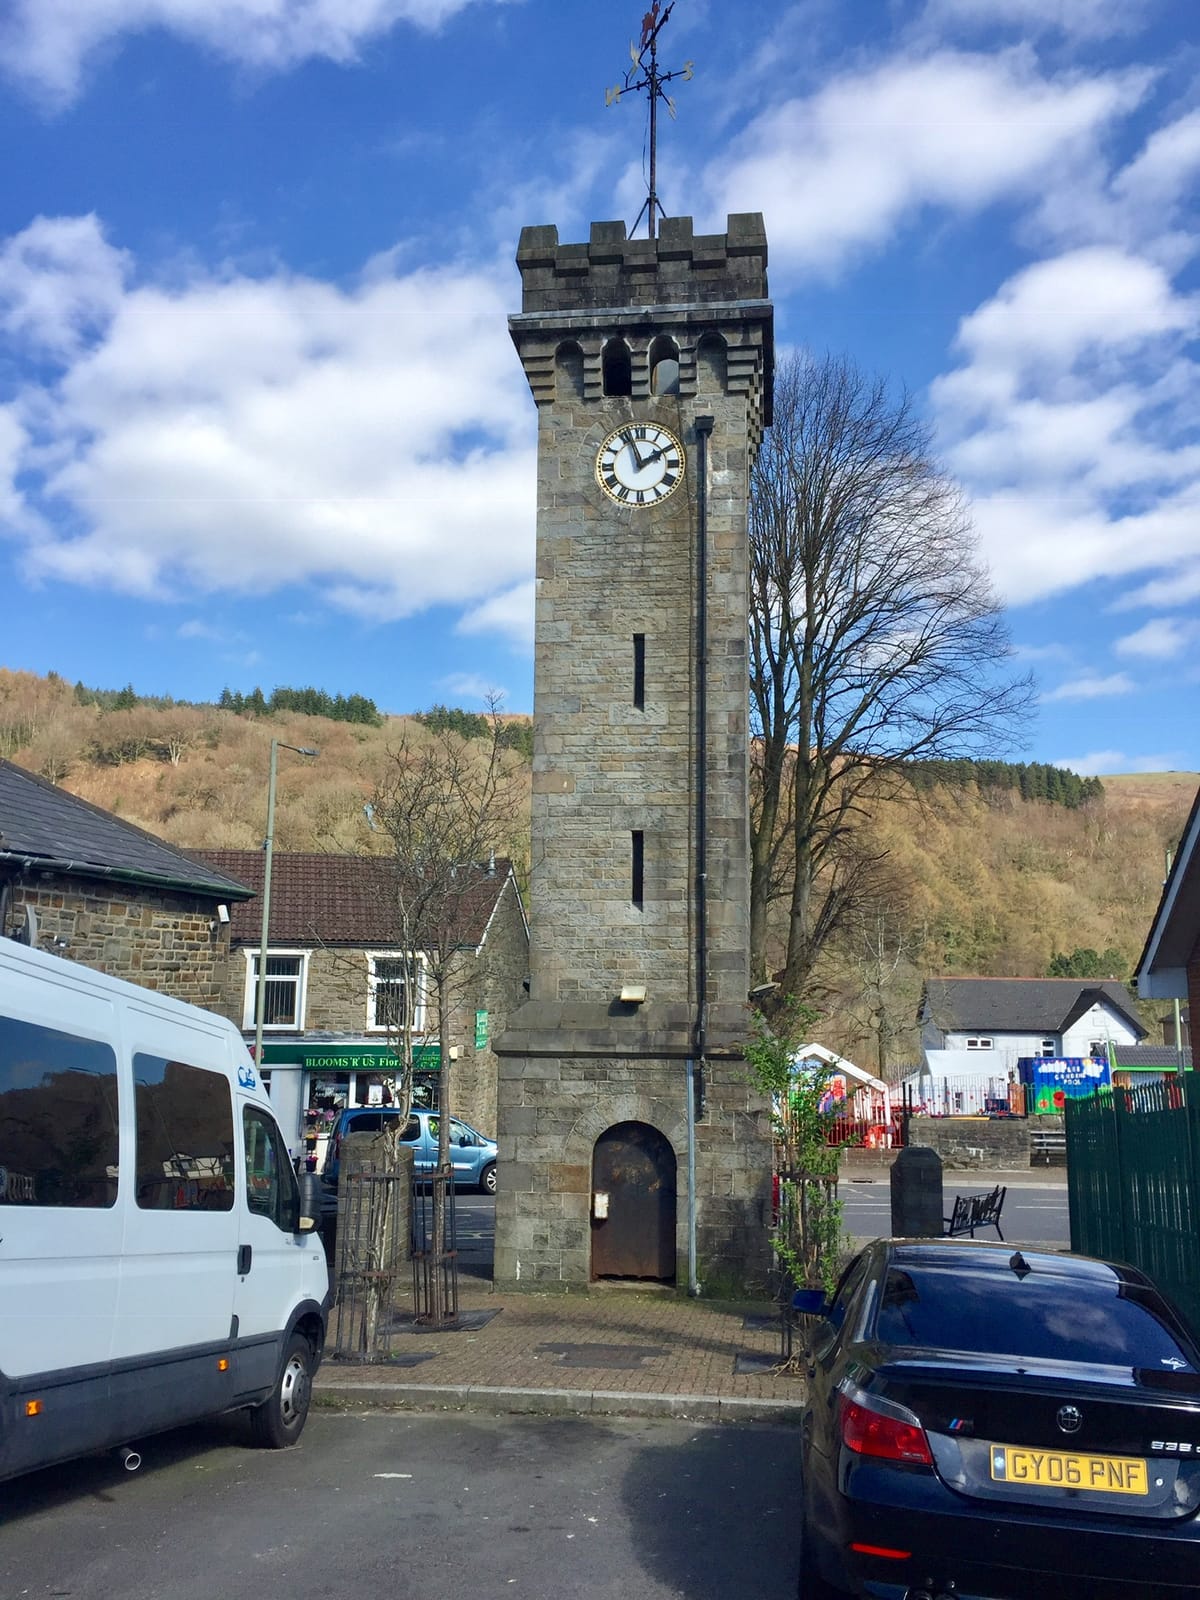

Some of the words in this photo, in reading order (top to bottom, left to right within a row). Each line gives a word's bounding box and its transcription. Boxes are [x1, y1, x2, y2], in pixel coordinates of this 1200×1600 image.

[305, 1058, 349, 1067] BLOOMS
[362, 1057, 376, 1066] US
[1012, 1453, 1081, 1484] GY06
[1089, 1461, 1141, 1489] PNF
